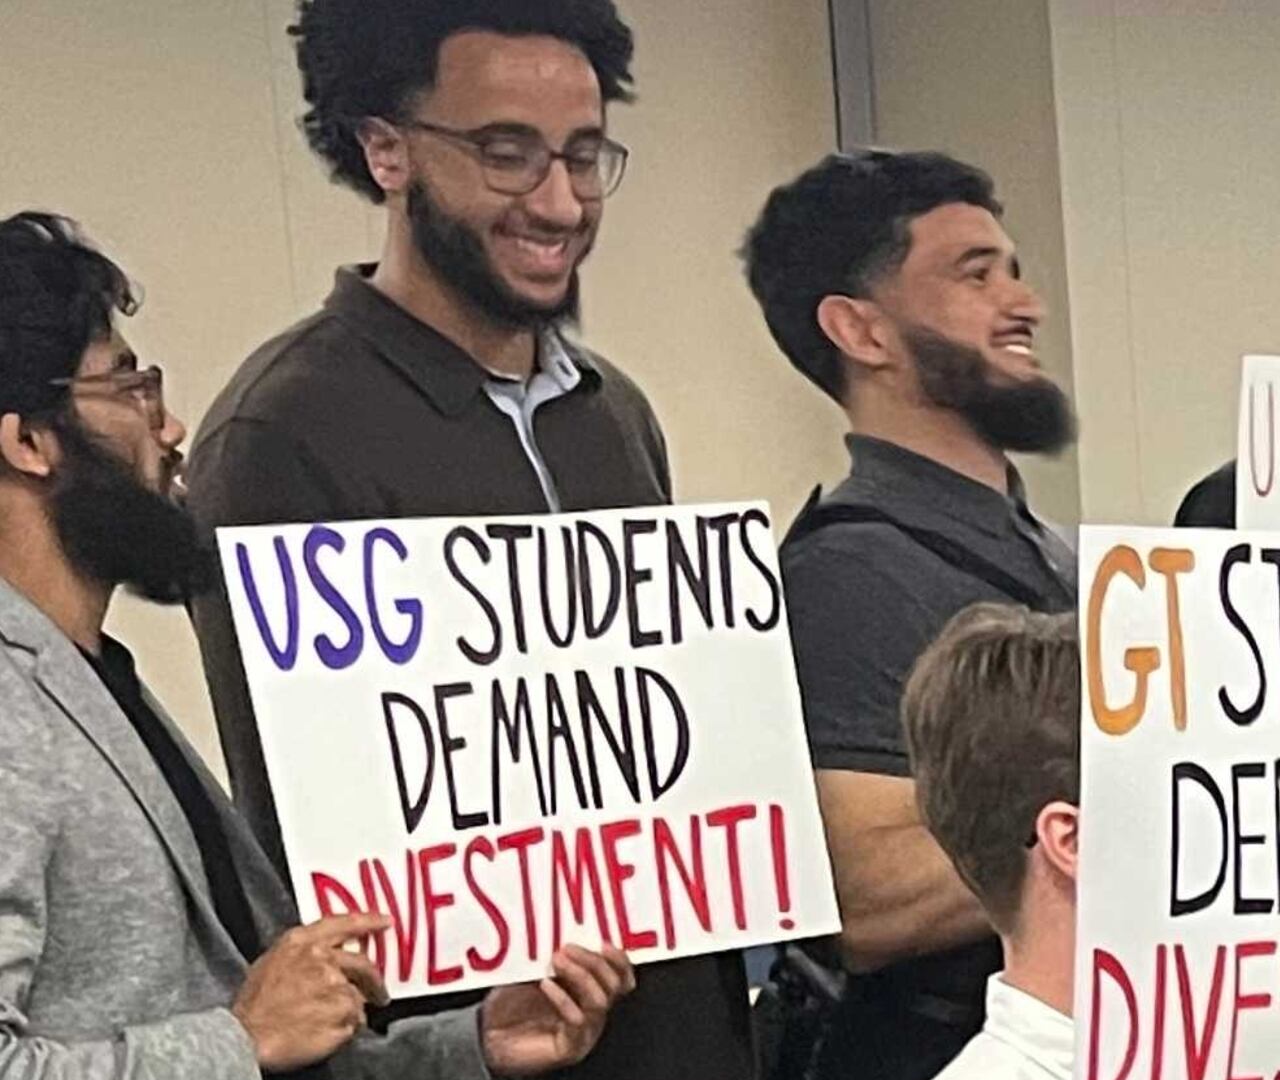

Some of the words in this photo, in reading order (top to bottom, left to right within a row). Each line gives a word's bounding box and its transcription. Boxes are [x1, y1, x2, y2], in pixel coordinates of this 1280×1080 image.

[236, 525, 423, 671] USG
[443, 509, 781, 665] STUDENTS
[1086, 544, 1195, 736] GT
[381, 666, 690, 833] DEMAND
